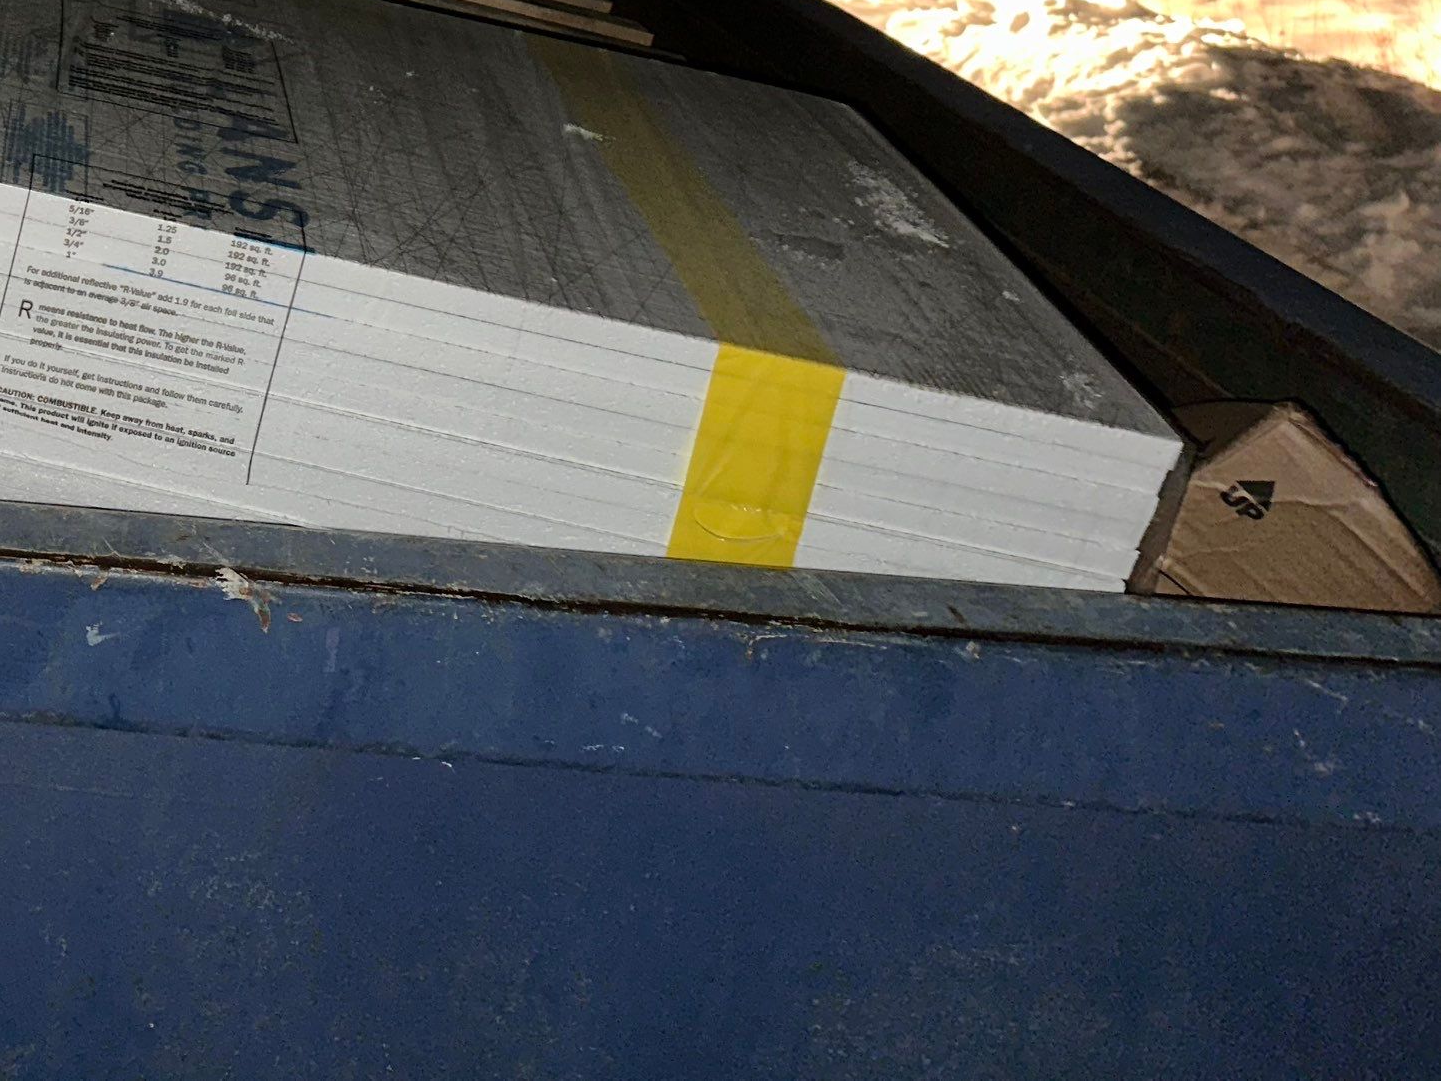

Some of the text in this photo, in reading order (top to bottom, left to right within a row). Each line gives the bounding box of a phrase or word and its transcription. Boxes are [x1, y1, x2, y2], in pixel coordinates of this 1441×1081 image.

[158, 224, 177, 234] 1.25
[157, 235, 172, 244] 1.5
[231, 241, 246, 249] 192
[154, 246, 170, 255] 2.0
[227, 251, 245, 260] 192
[152, 257, 166, 266] 3.0
[225, 262, 242, 271] 192
[148, 268, 163, 279] 3.9
[225, 273, 236, 282] 96
[27, 266, 40, 274] For
[41, 270, 80, 283] additional
[81, 278, 117, 291] reflective
[157, 294, 173, 303] add
[175, 297, 189, 306] 1.9
[190, 300, 202, 309] for
[203, 305, 222, 313] each
[239, 312, 256, 321] side
[258, 316, 274, 325] that
[33, 280, 65, 292] adjacent
[88, 292, 118, 304] average
[222, 284, 233, 292] 96
[18, 299, 33, 319] R
[38, 305, 65, 315] means
[67, 310, 107, 324] resistance
[119, 320, 137, 331] heat
[159, 329, 173, 338] The
[175, 332, 200, 344] higher
[201, 339, 214, 347] the
[50, 319, 79, 329] greater
[81, 325, 94, 333] the
[96, 328, 135, 343] insulating
[165, 342, 173, 350] To
[175, 346, 189, 354] get
[191, 349, 203, 357] the
[206, 353, 236, 364] marked
[74, 336, 109, 348] essential
[111, 343, 126, 352] that
[128, 347, 143, 355] this
[145, 350, 182, 364] insulation
[184, 358, 194, 366] be
[196, 361, 229, 374] installed
[27, 360, 37, 368] do
[97, 374, 143, 391] instructions
[162, 388, 185, 400] follow
[187, 394, 207, 405] them
[60, 378, 74, 387] not
[75, 383, 97, 392] come
[99, 388, 115, 397] with
[117, 391, 131, 400] this
[41, 417, 58, 426] heat
[60, 423, 75, 431] and
[100, 409, 120, 420] Keep
[122, 416, 143, 425] away
[145, 419, 163, 429] from
[21, 402, 36, 412] This
[38, 408, 69, 419] product
[87, 418, 109, 429] ignite
[119, 427, 152, 438] exposed
[177, 438, 206, 450] ignition
[208, 447, 235, 457] source
[1220, 484, 1265, 521] UP
